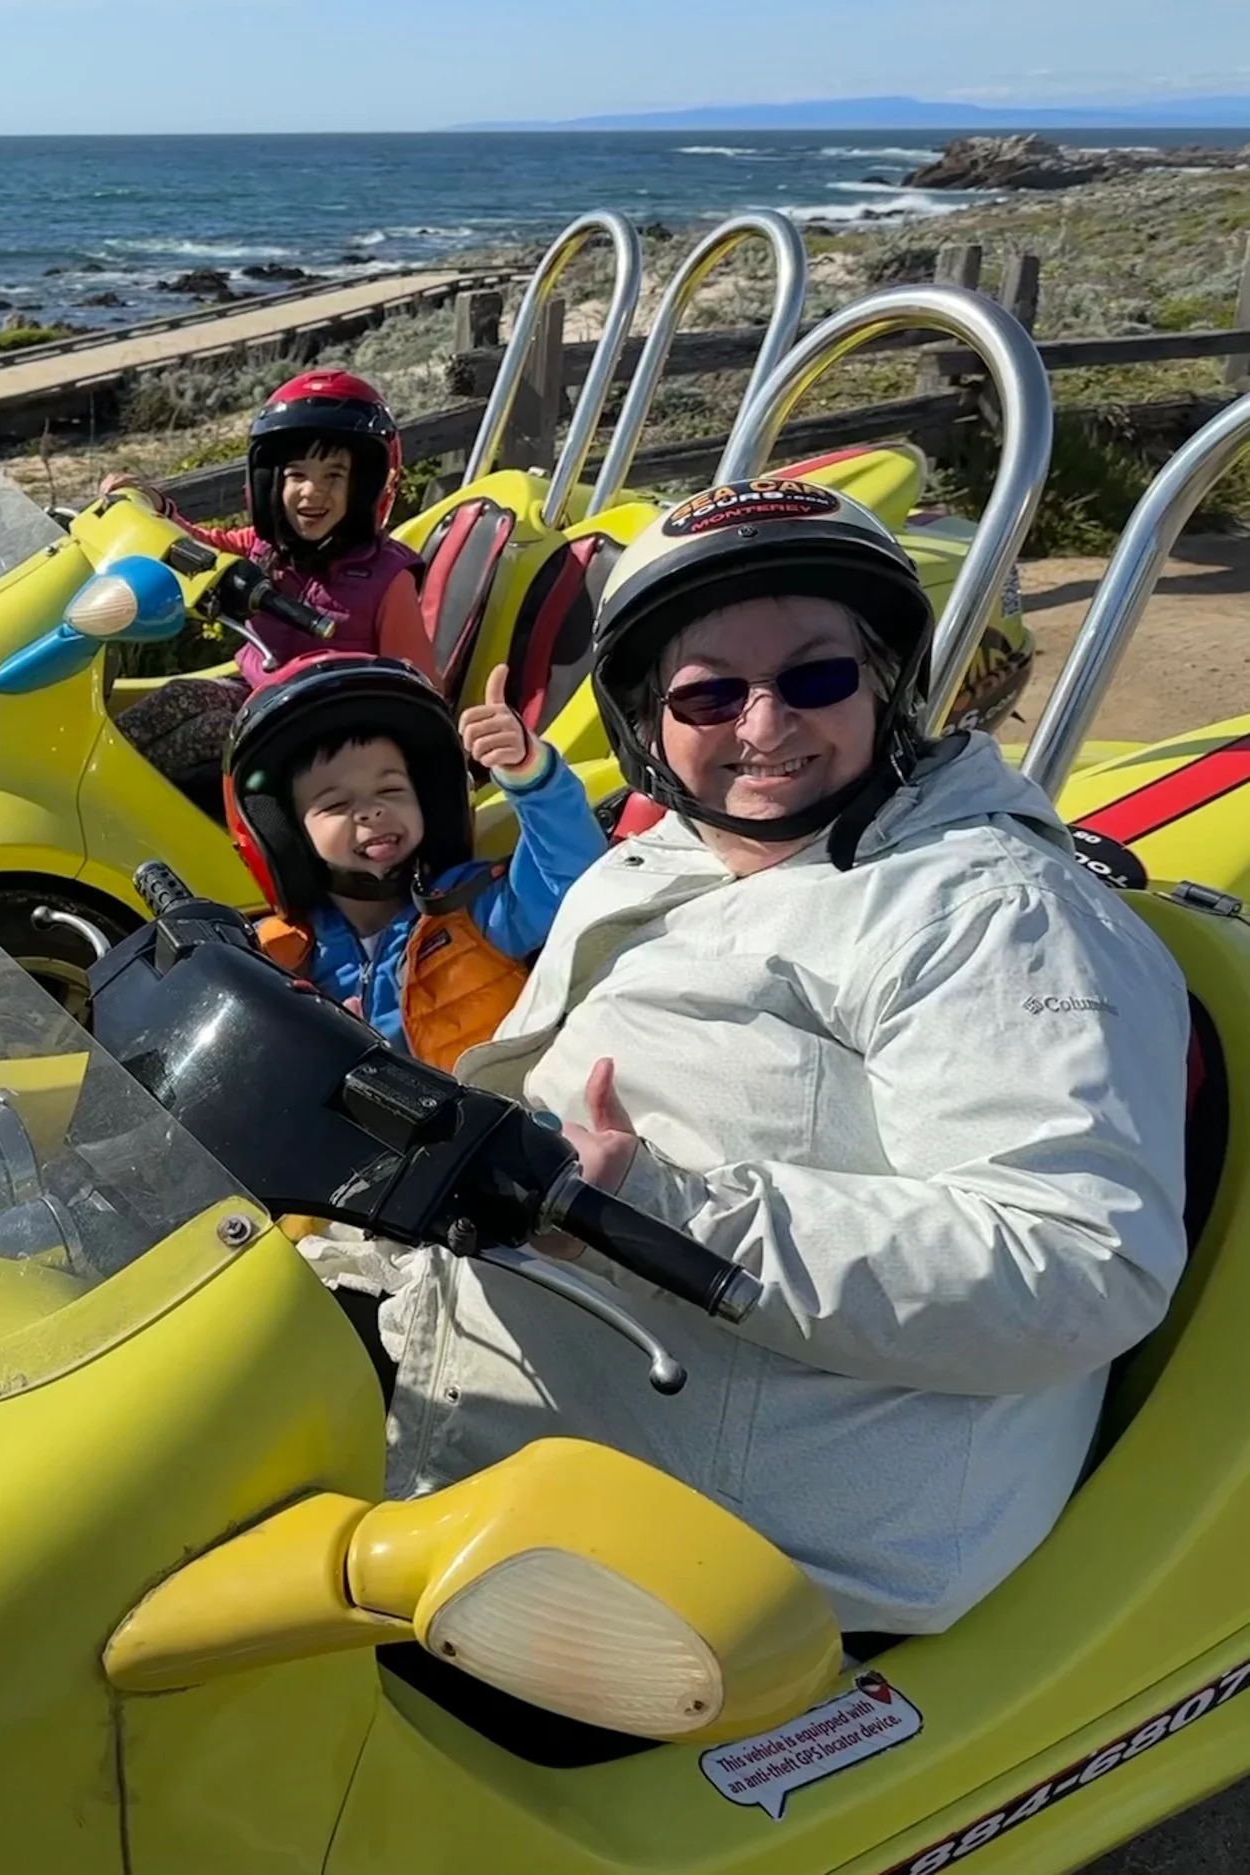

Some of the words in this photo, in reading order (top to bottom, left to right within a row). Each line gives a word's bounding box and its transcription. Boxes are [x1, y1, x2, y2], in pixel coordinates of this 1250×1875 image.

[670, 487, 735, 522] SEA
[750, 479, 827, 498] CAR
[691, 503, 811, 532] MONTEREY
[716, 1753, 747, 1773] This
[743, 1737, 787, 1764] vehicle
[781, 1734, 798, 1751] is
[796, 1711, 849, 1744] equipped
[847, 1700, 875, 1720] with
[728, 1779, 747, 1794] an
[746, 1756, 801, 1788] anti-theft
[796, 1747, 824, 1766] GPS
[820, 1731, 863, 1756] locator
[860, 1714, 903, 1738] device.
